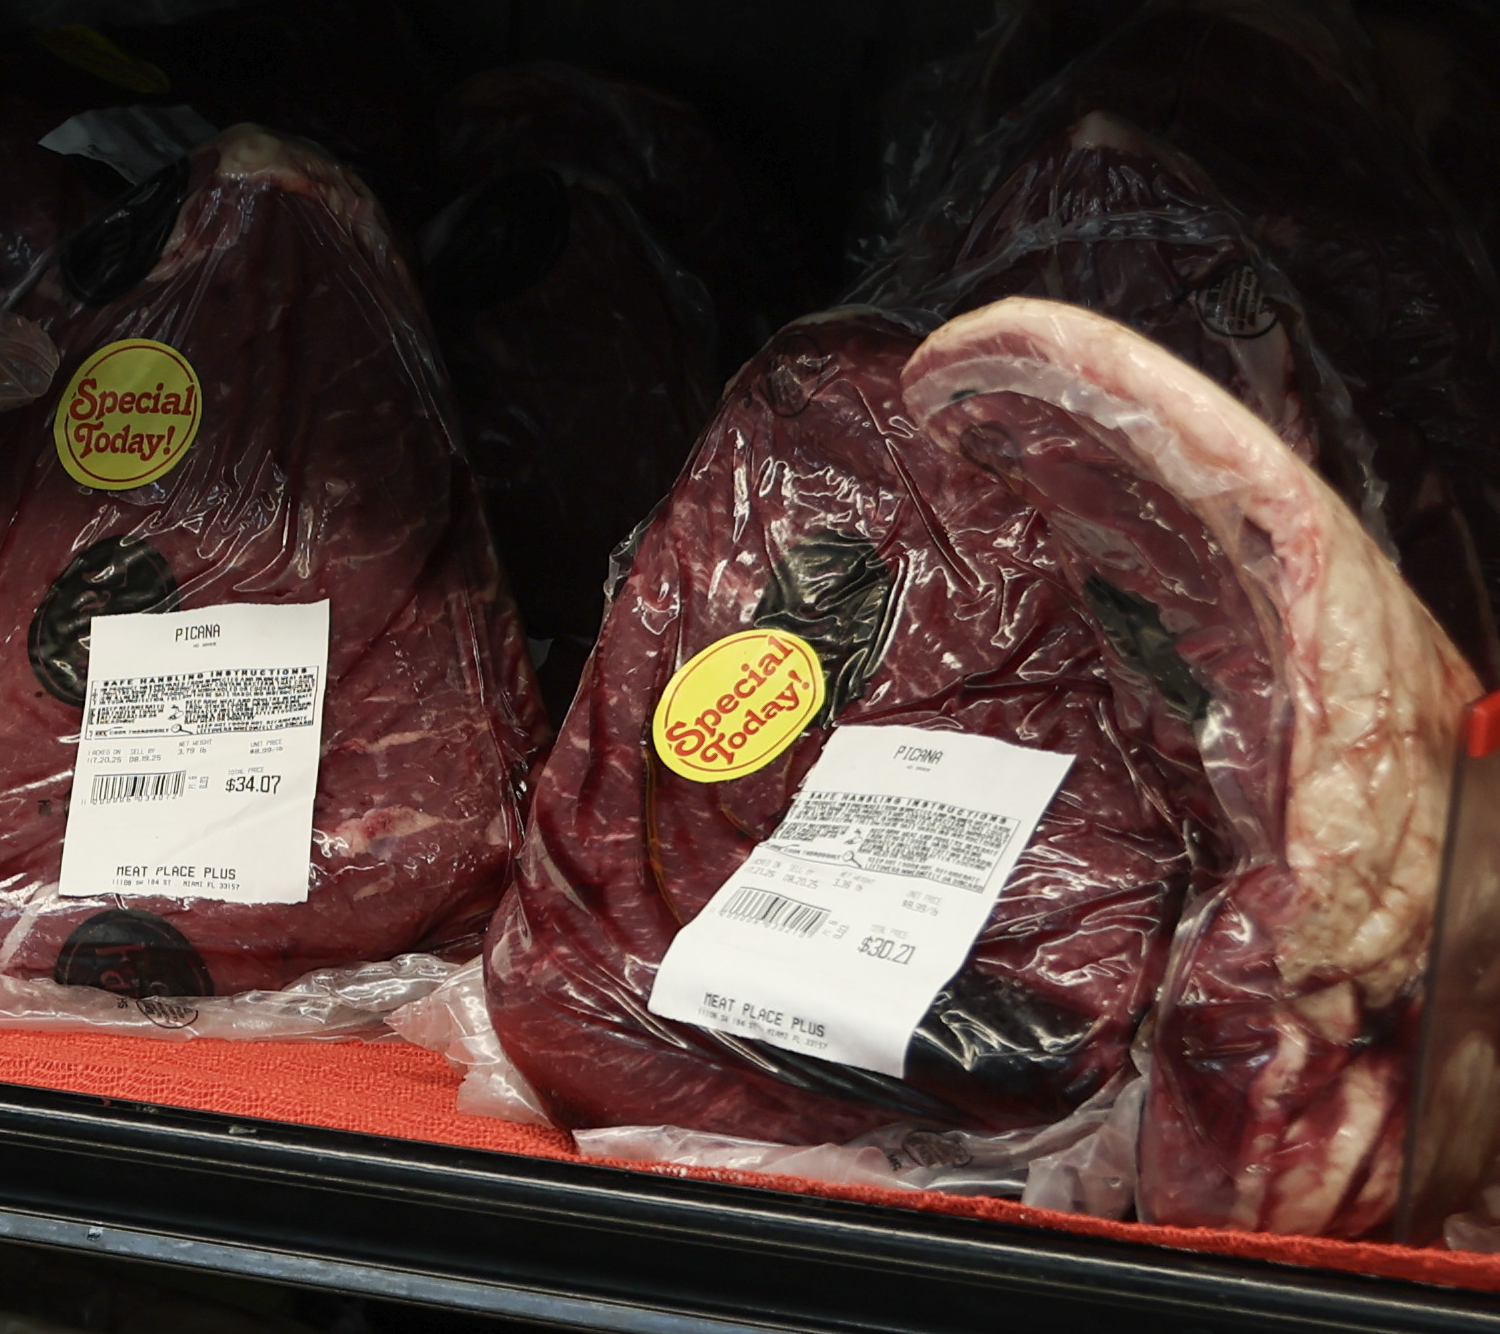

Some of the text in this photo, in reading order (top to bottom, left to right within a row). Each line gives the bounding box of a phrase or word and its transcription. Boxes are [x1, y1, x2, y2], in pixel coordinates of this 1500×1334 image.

[70, 378, 195, 421] Special
[74, 421, 176, 462] Today!
[174, 623, 221, 643] PICANA
[665, 635, 794, 757] Special
[700, 669, 810, 766] Today!
[893, 744, 945, 765] PICANA
[224, 774, 283, 796] $34.07
[115, 865, 237, 881] MEAT PLACE PLUS
[857, 935, 917, 967] $30.21
[703, 991, 826, 1038] MEAT PLACE PLUS
